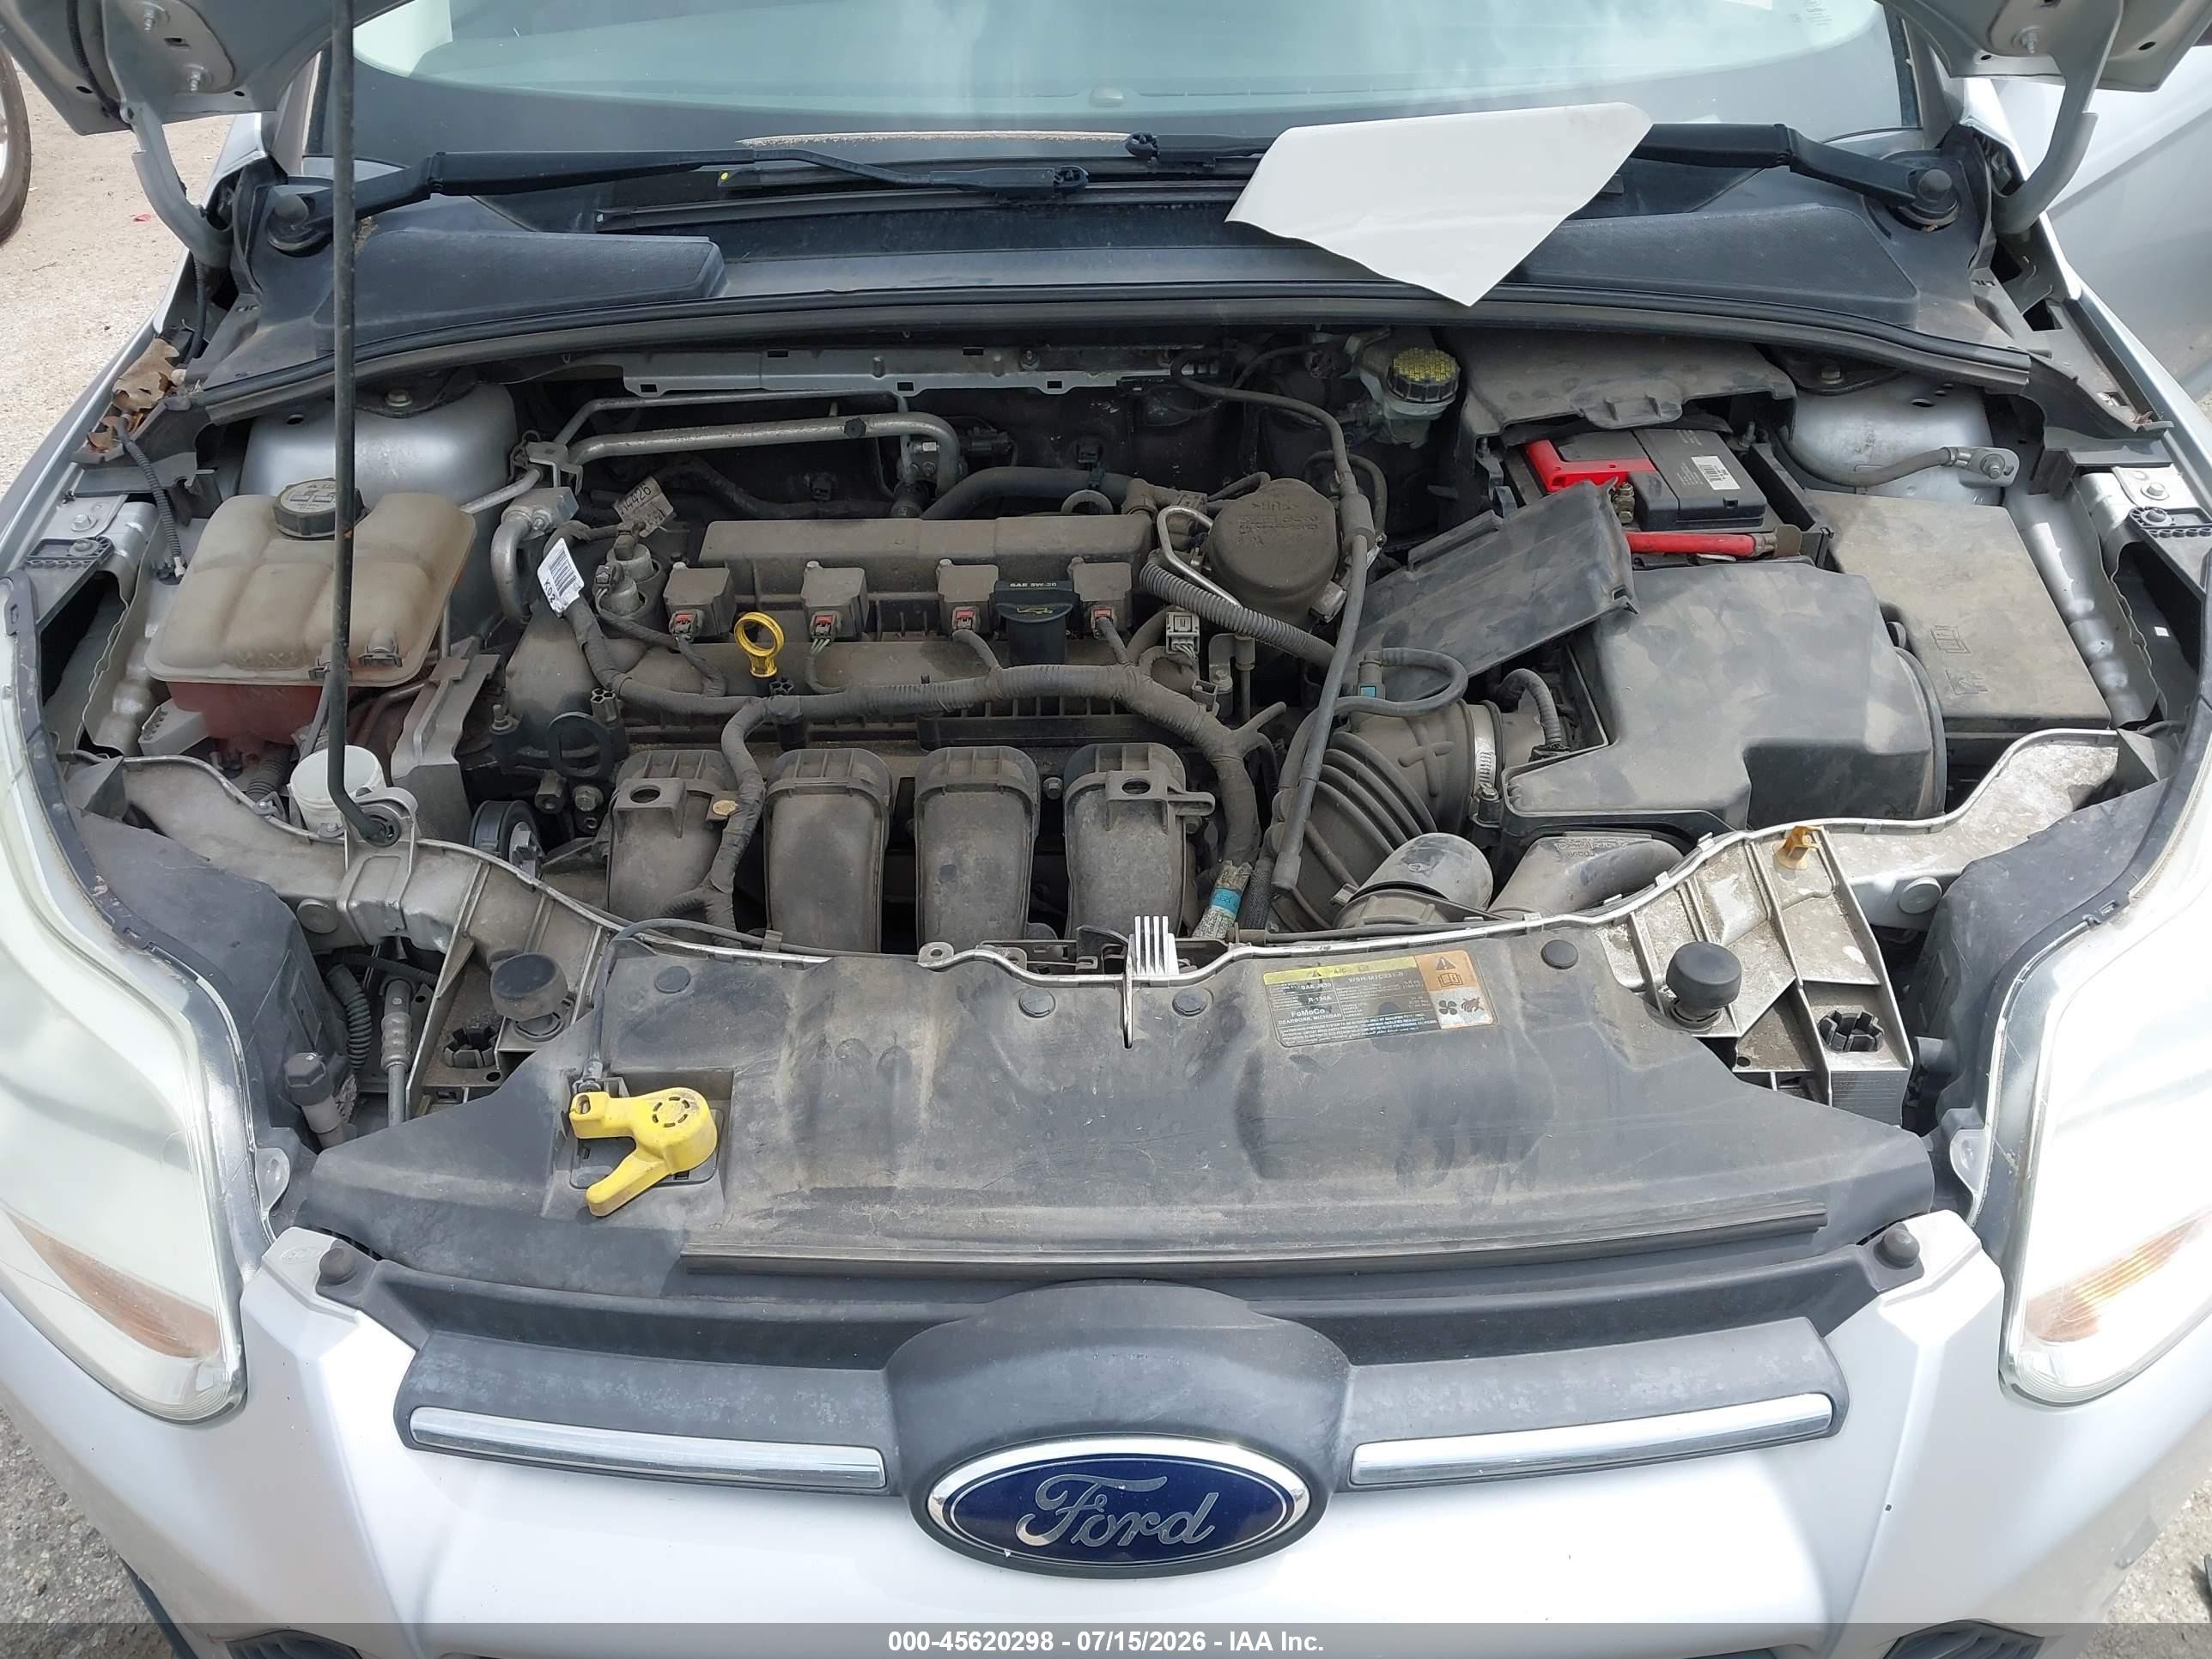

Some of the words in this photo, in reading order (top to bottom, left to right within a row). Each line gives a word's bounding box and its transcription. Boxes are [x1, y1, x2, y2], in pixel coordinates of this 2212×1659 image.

[544, 579, 556, 603] K02
[1291, 1008, 1325, 1018] FoMoCo
[1016, 1474, 1219, 1547] Ford
